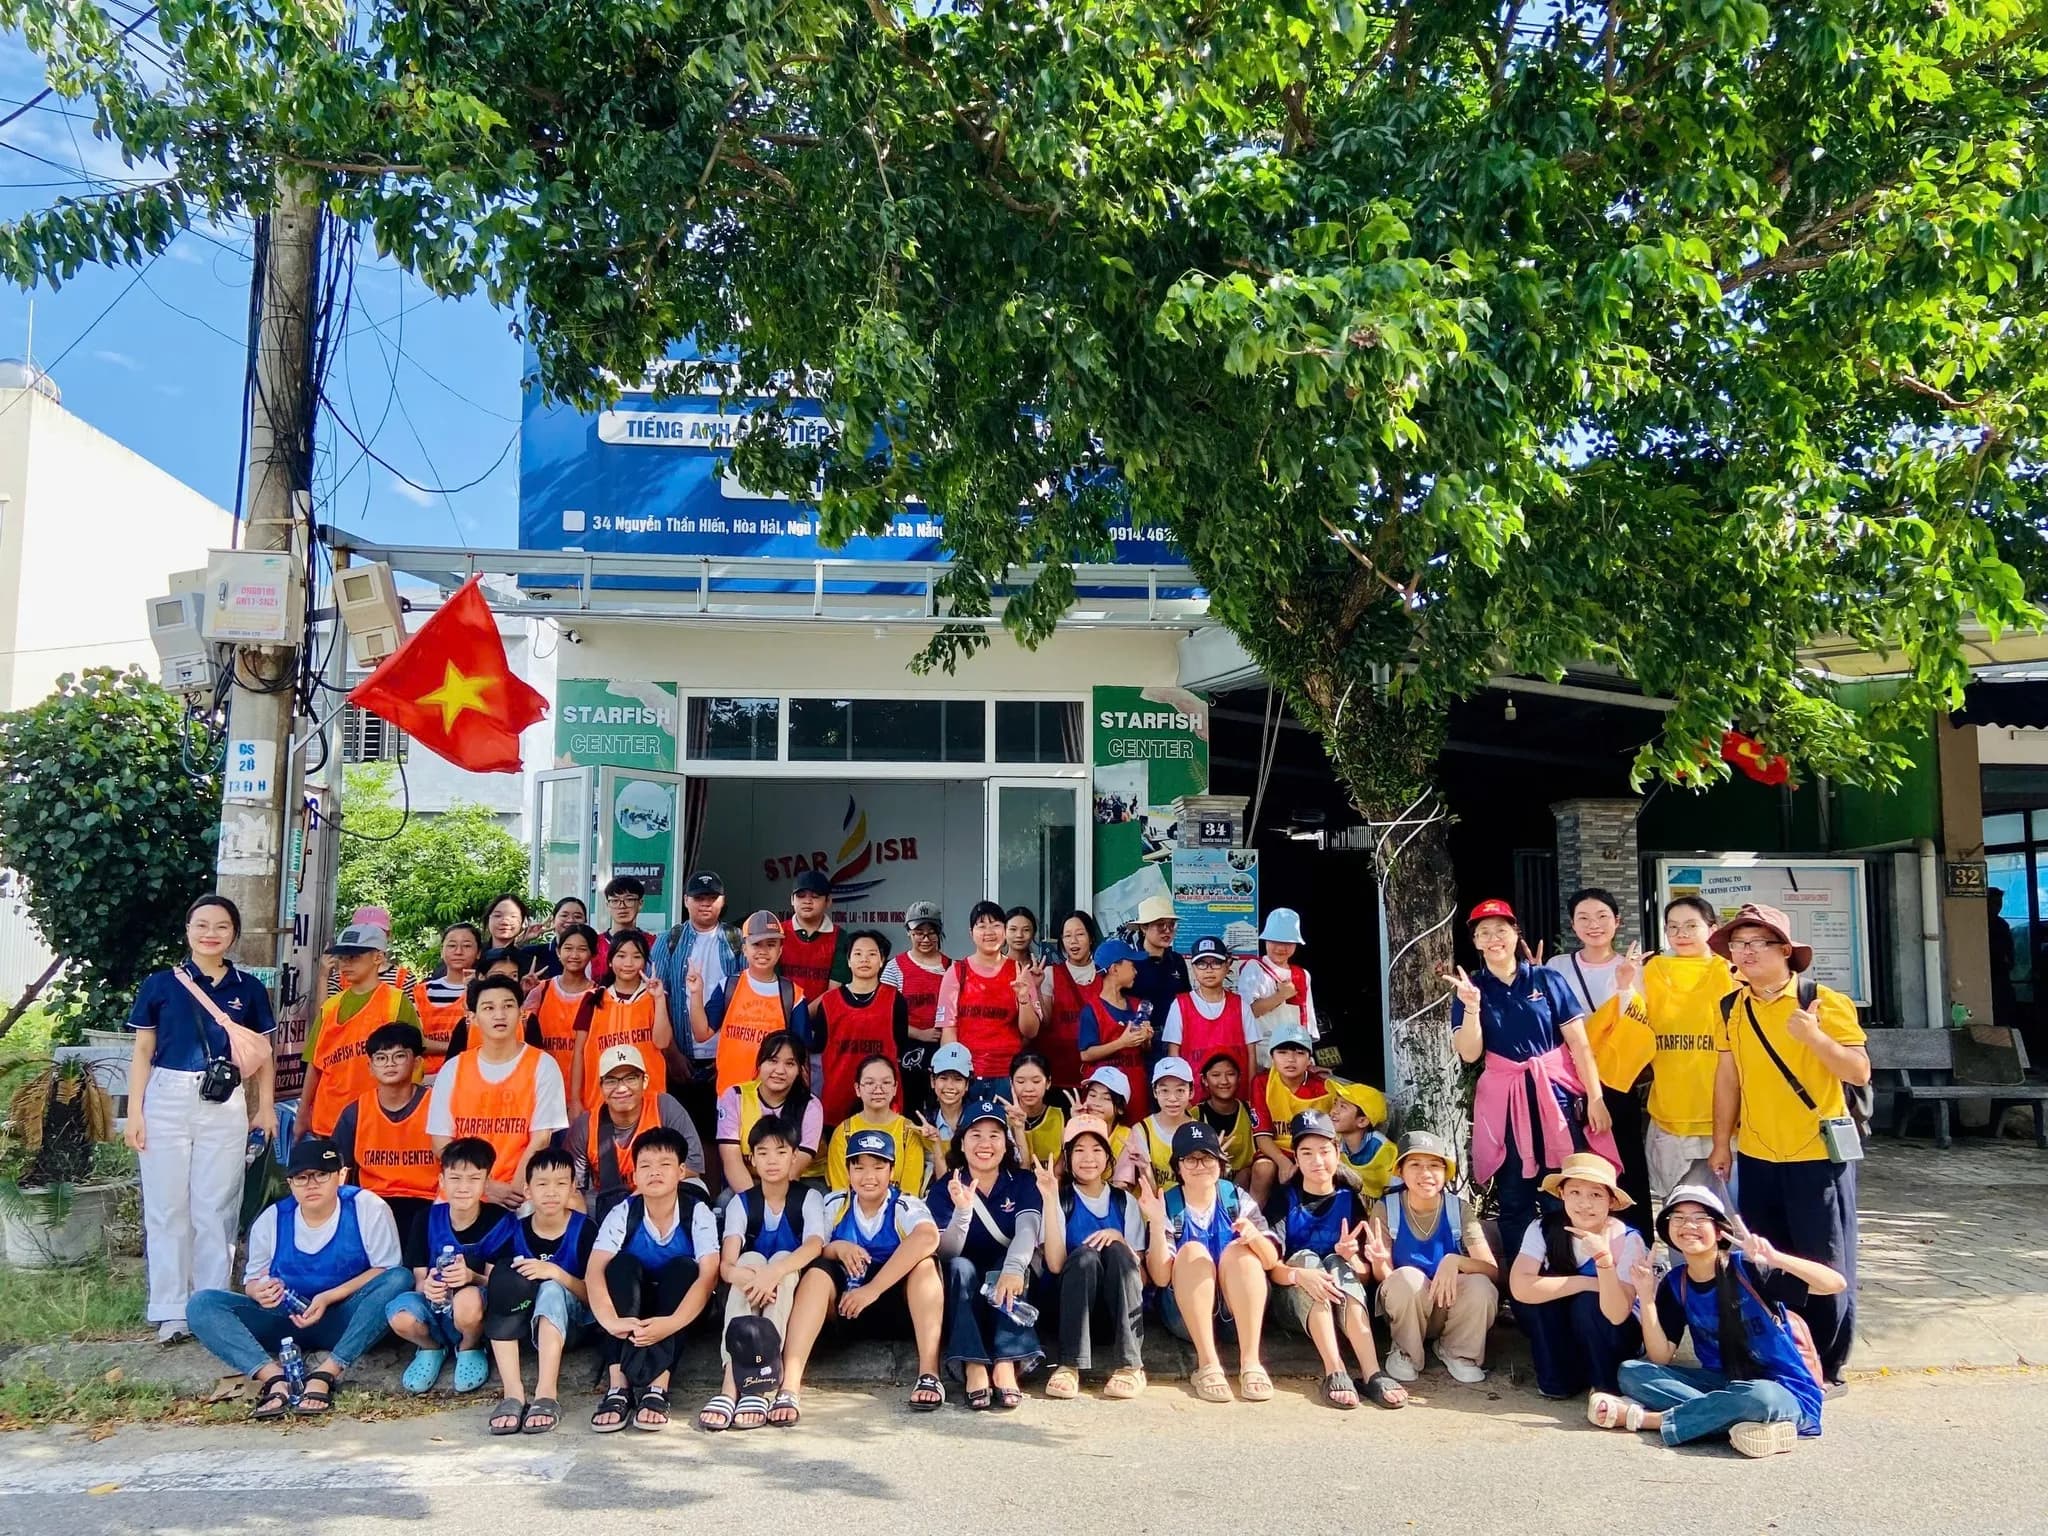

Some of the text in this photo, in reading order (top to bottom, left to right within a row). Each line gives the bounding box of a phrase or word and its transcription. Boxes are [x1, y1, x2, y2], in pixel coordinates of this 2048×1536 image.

[626, 415, 683, 439] TIẾNG
[689, 422, 731, 442] ANH
[788, 420, 830, 442] TIẾP
[592, 515, 611, 531] 34
[615, 514, 662, 533] Nguyễn
[666, 515, 695, 533] Thần
[733, 518, 757, 534] Hòa
[562, 705, 671, 727] STARFISH
[1100, 711, 1203, 732] STARFISH
[570, 733, 661, 755] CENTER
[1107, 738, 1194, 759] CENTER
[258, 780, 266, 792] H
[1205, 822, 1227, 837] 34
[613, 866, 650, 877] DREAM
[1955, 869, 1980, 885] 32
[1708, 876, 1733, 885] COMING
[1728, 885, 1752, 893] CENTER
[617, 1050, 627, 1061] LA
[454, 1117, 527, 1134] STARFISH CENTER
[1190, 1126, 1203, 1138] LA
[364, 1149, 434, 1166] STARFISH CENTER
[755, 1355, 762, 1363] B
